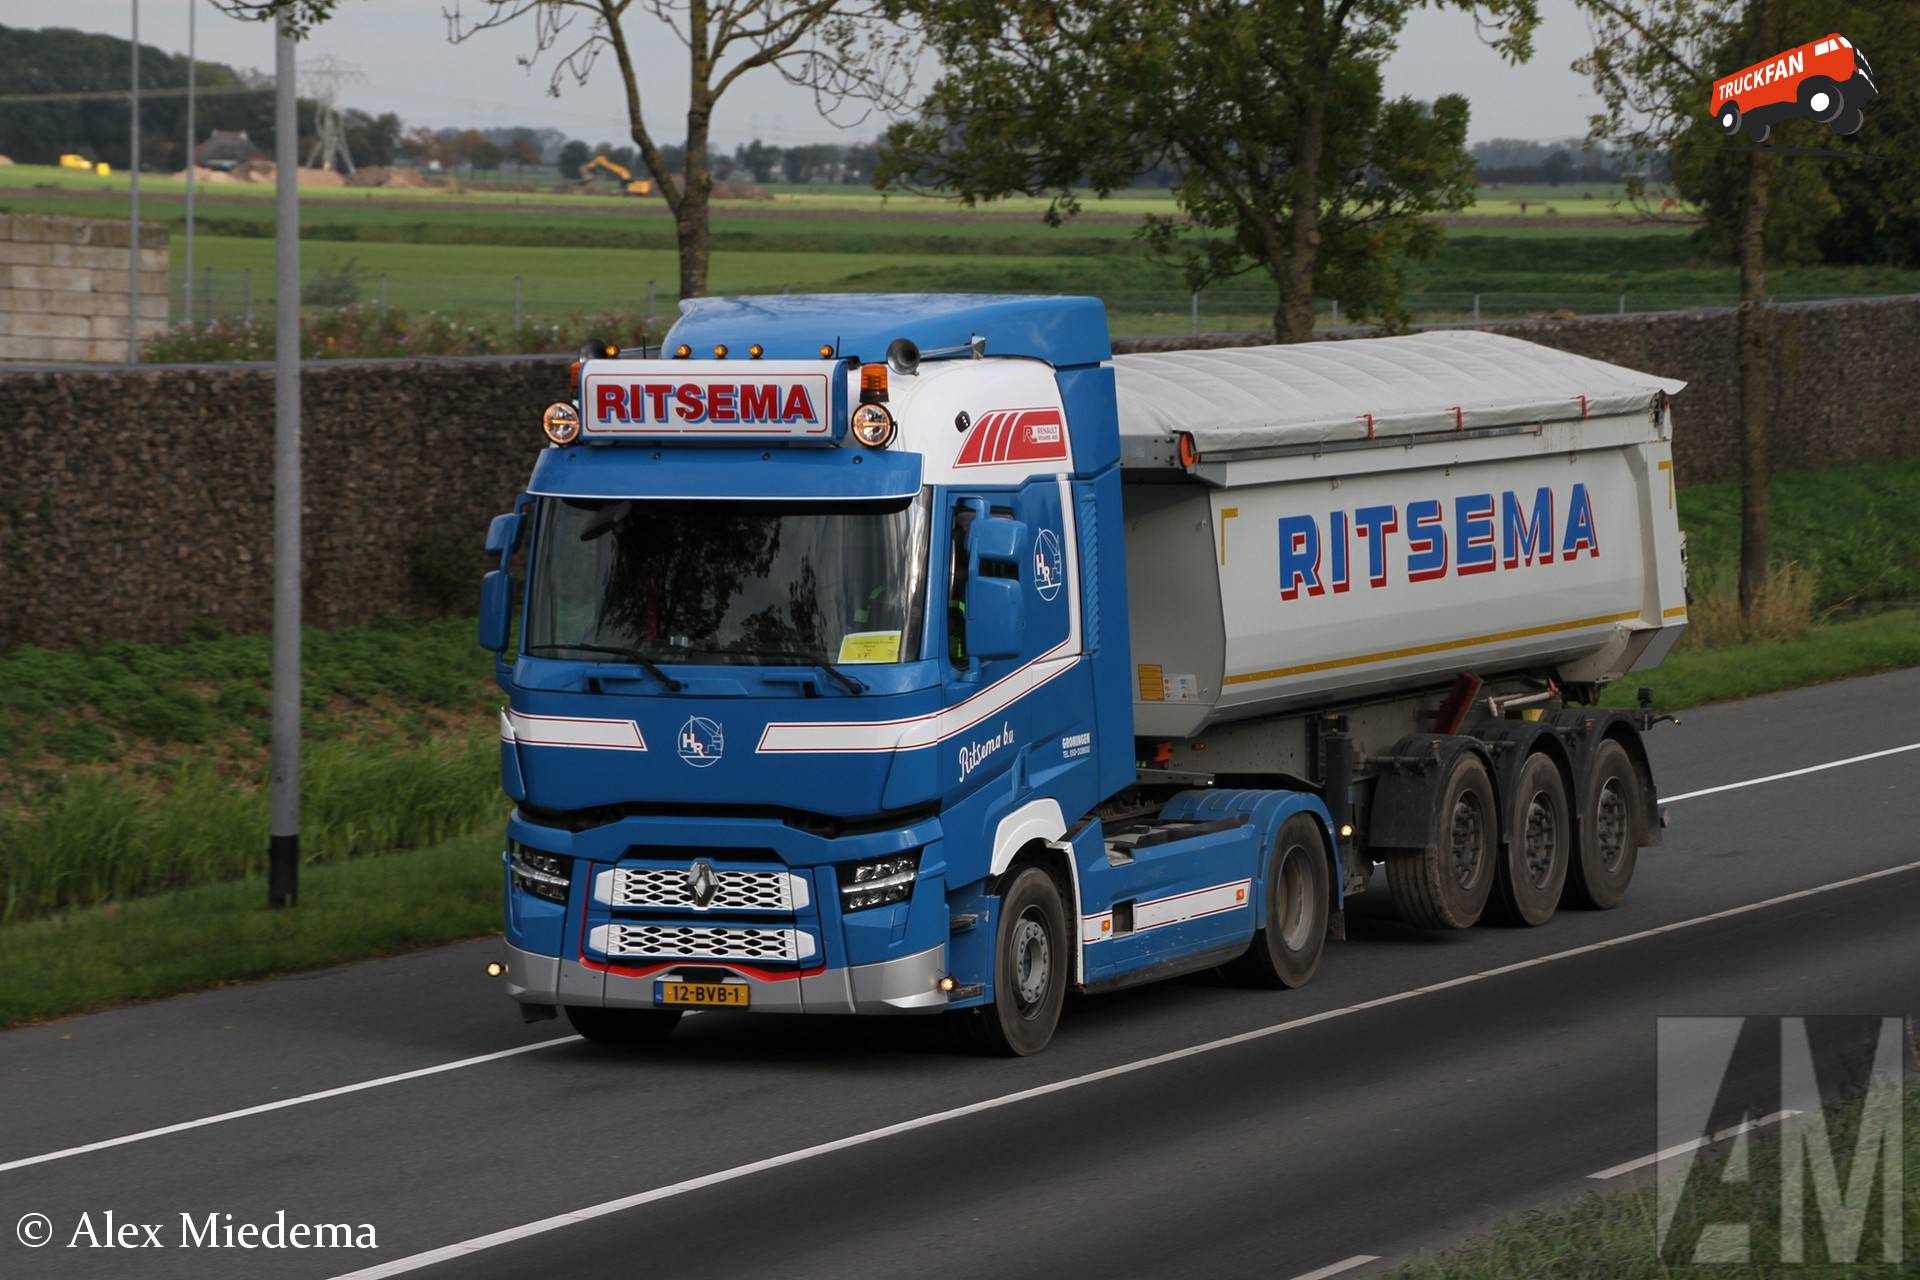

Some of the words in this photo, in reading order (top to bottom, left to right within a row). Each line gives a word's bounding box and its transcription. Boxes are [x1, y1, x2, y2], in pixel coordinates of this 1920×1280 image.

[596, 383, 818, 424] RITSEMA
[1278, 483, 1600, 601] RITSEMA
[959, 734, 1001, 783] Ritsema
[1062, 732, 1090, 749] GRONINGEN
[673, 985, 740, 1003] 12-BVB-1
